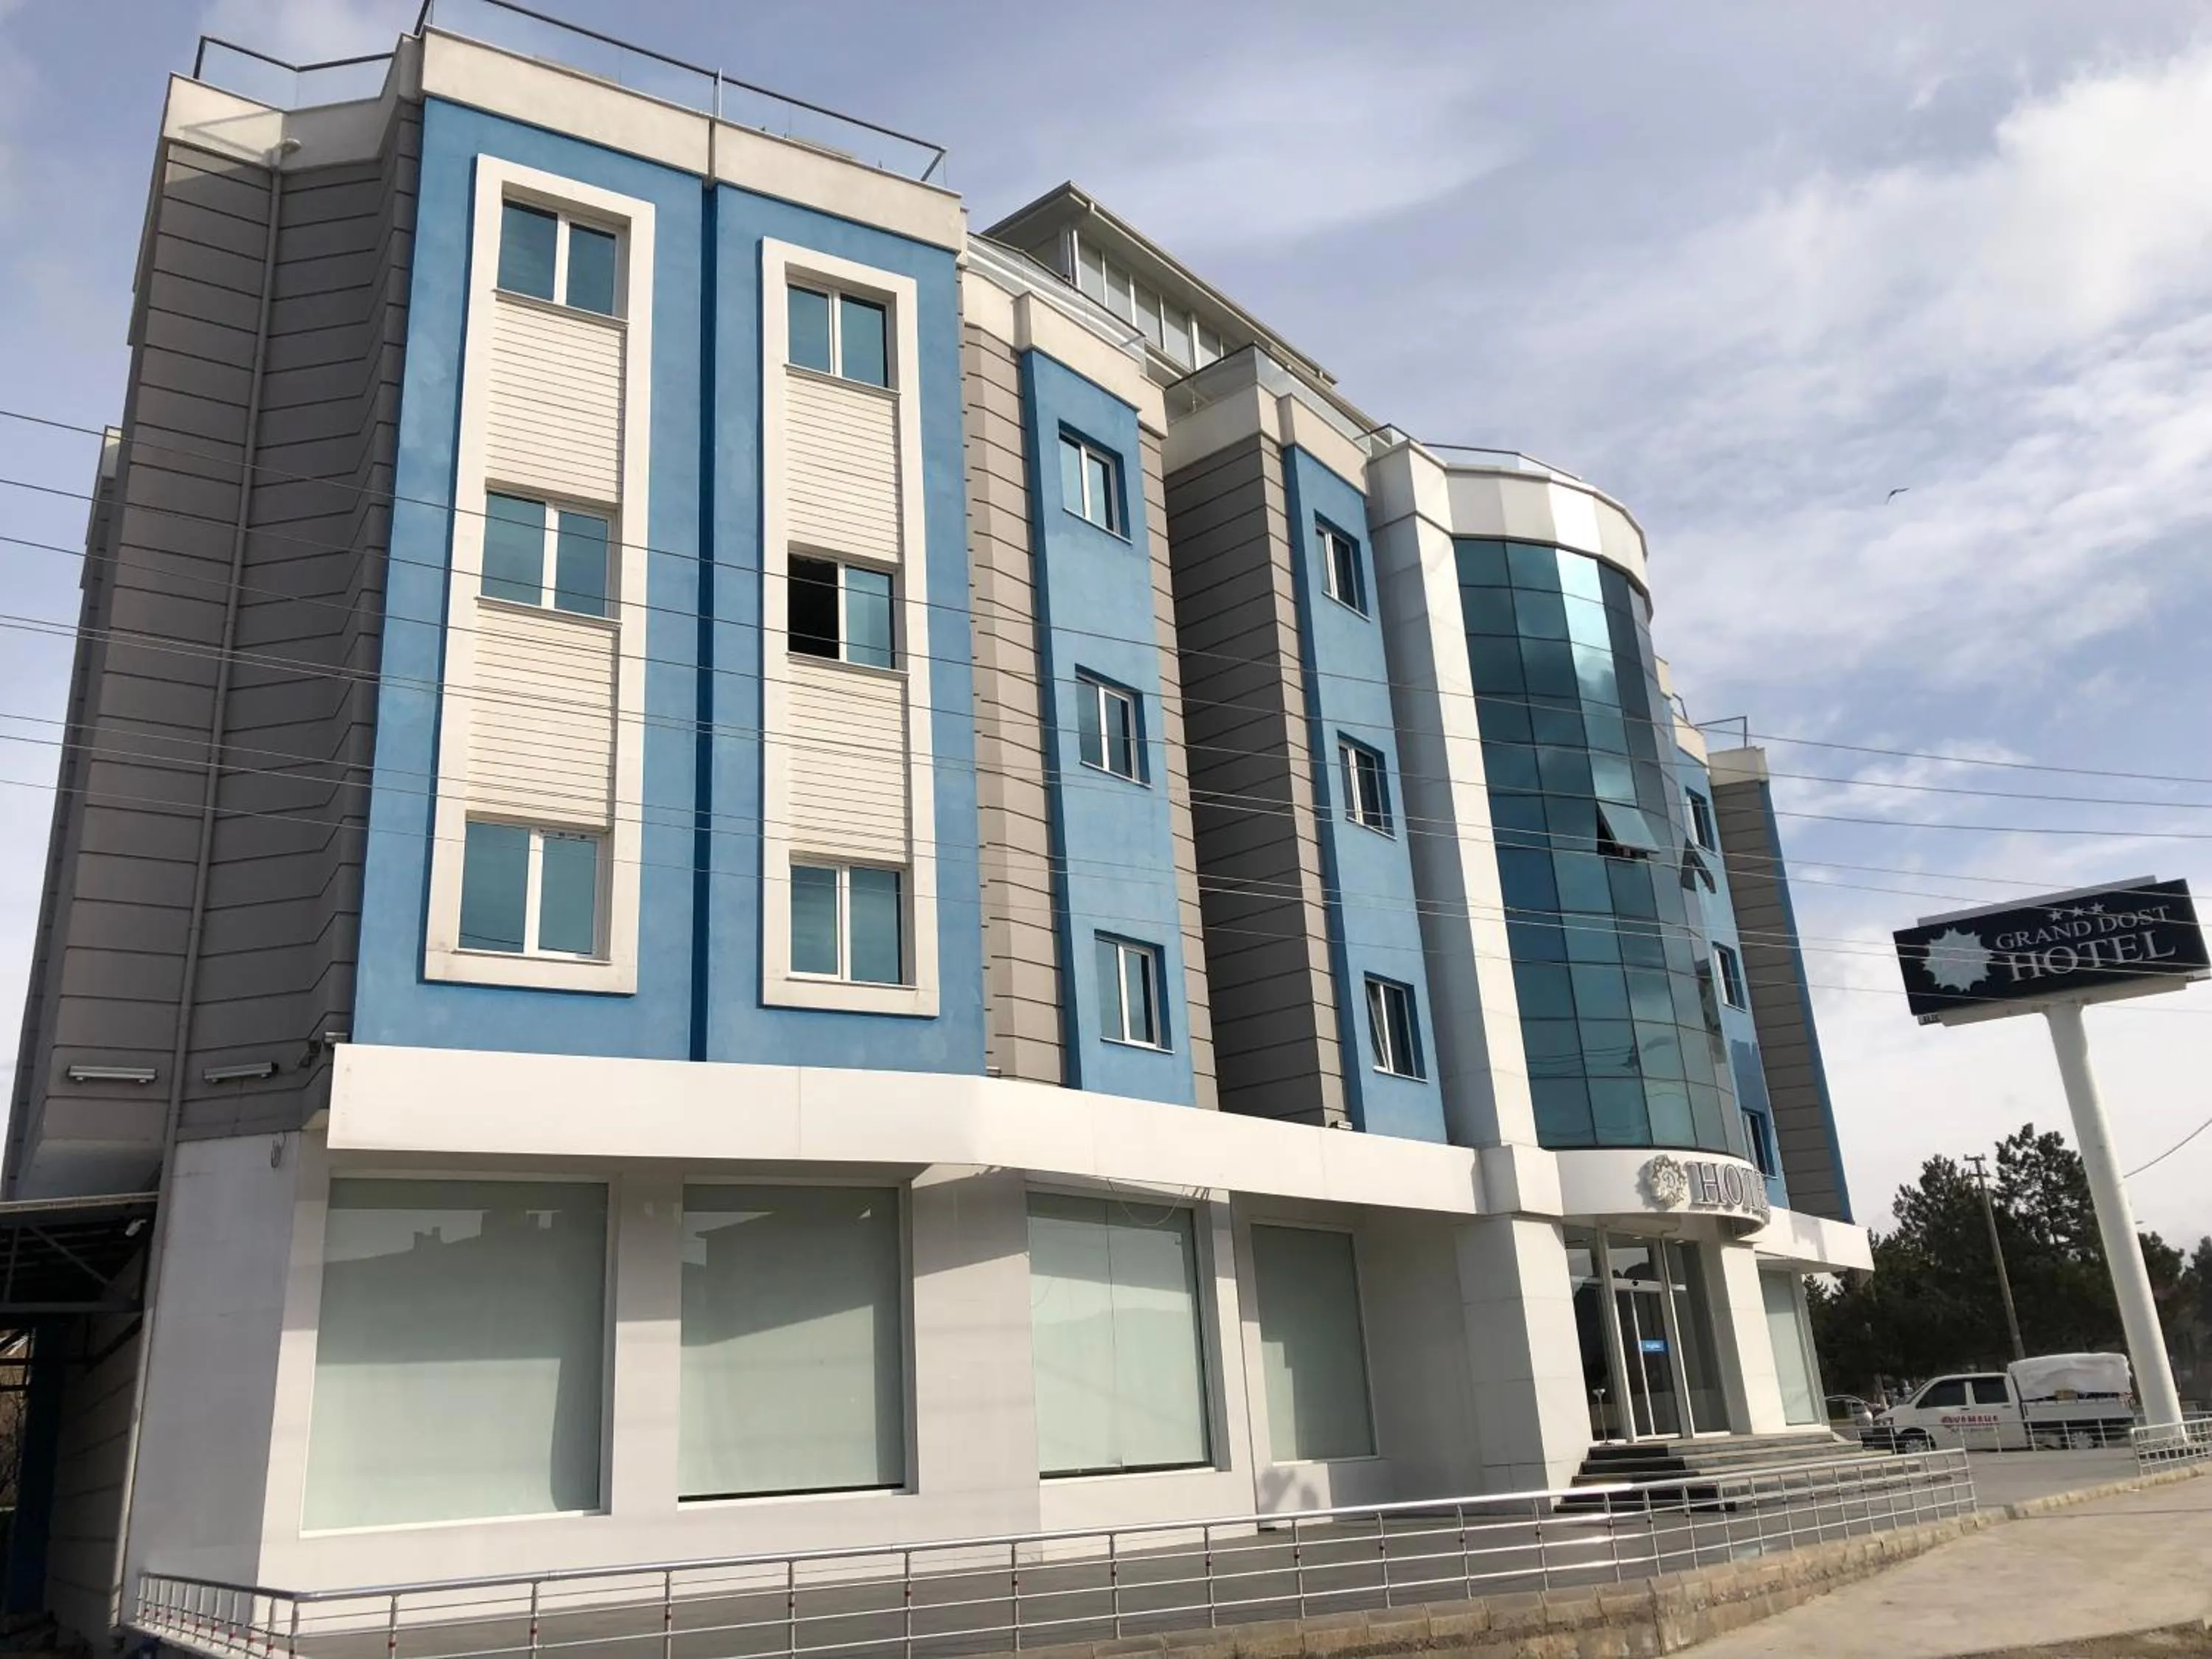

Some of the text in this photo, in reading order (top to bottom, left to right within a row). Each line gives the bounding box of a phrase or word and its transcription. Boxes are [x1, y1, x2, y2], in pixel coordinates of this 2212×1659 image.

[1996, 906, 2171, 950] GRAND DOST
[2006, 930, 2176, 982] HOTEL
